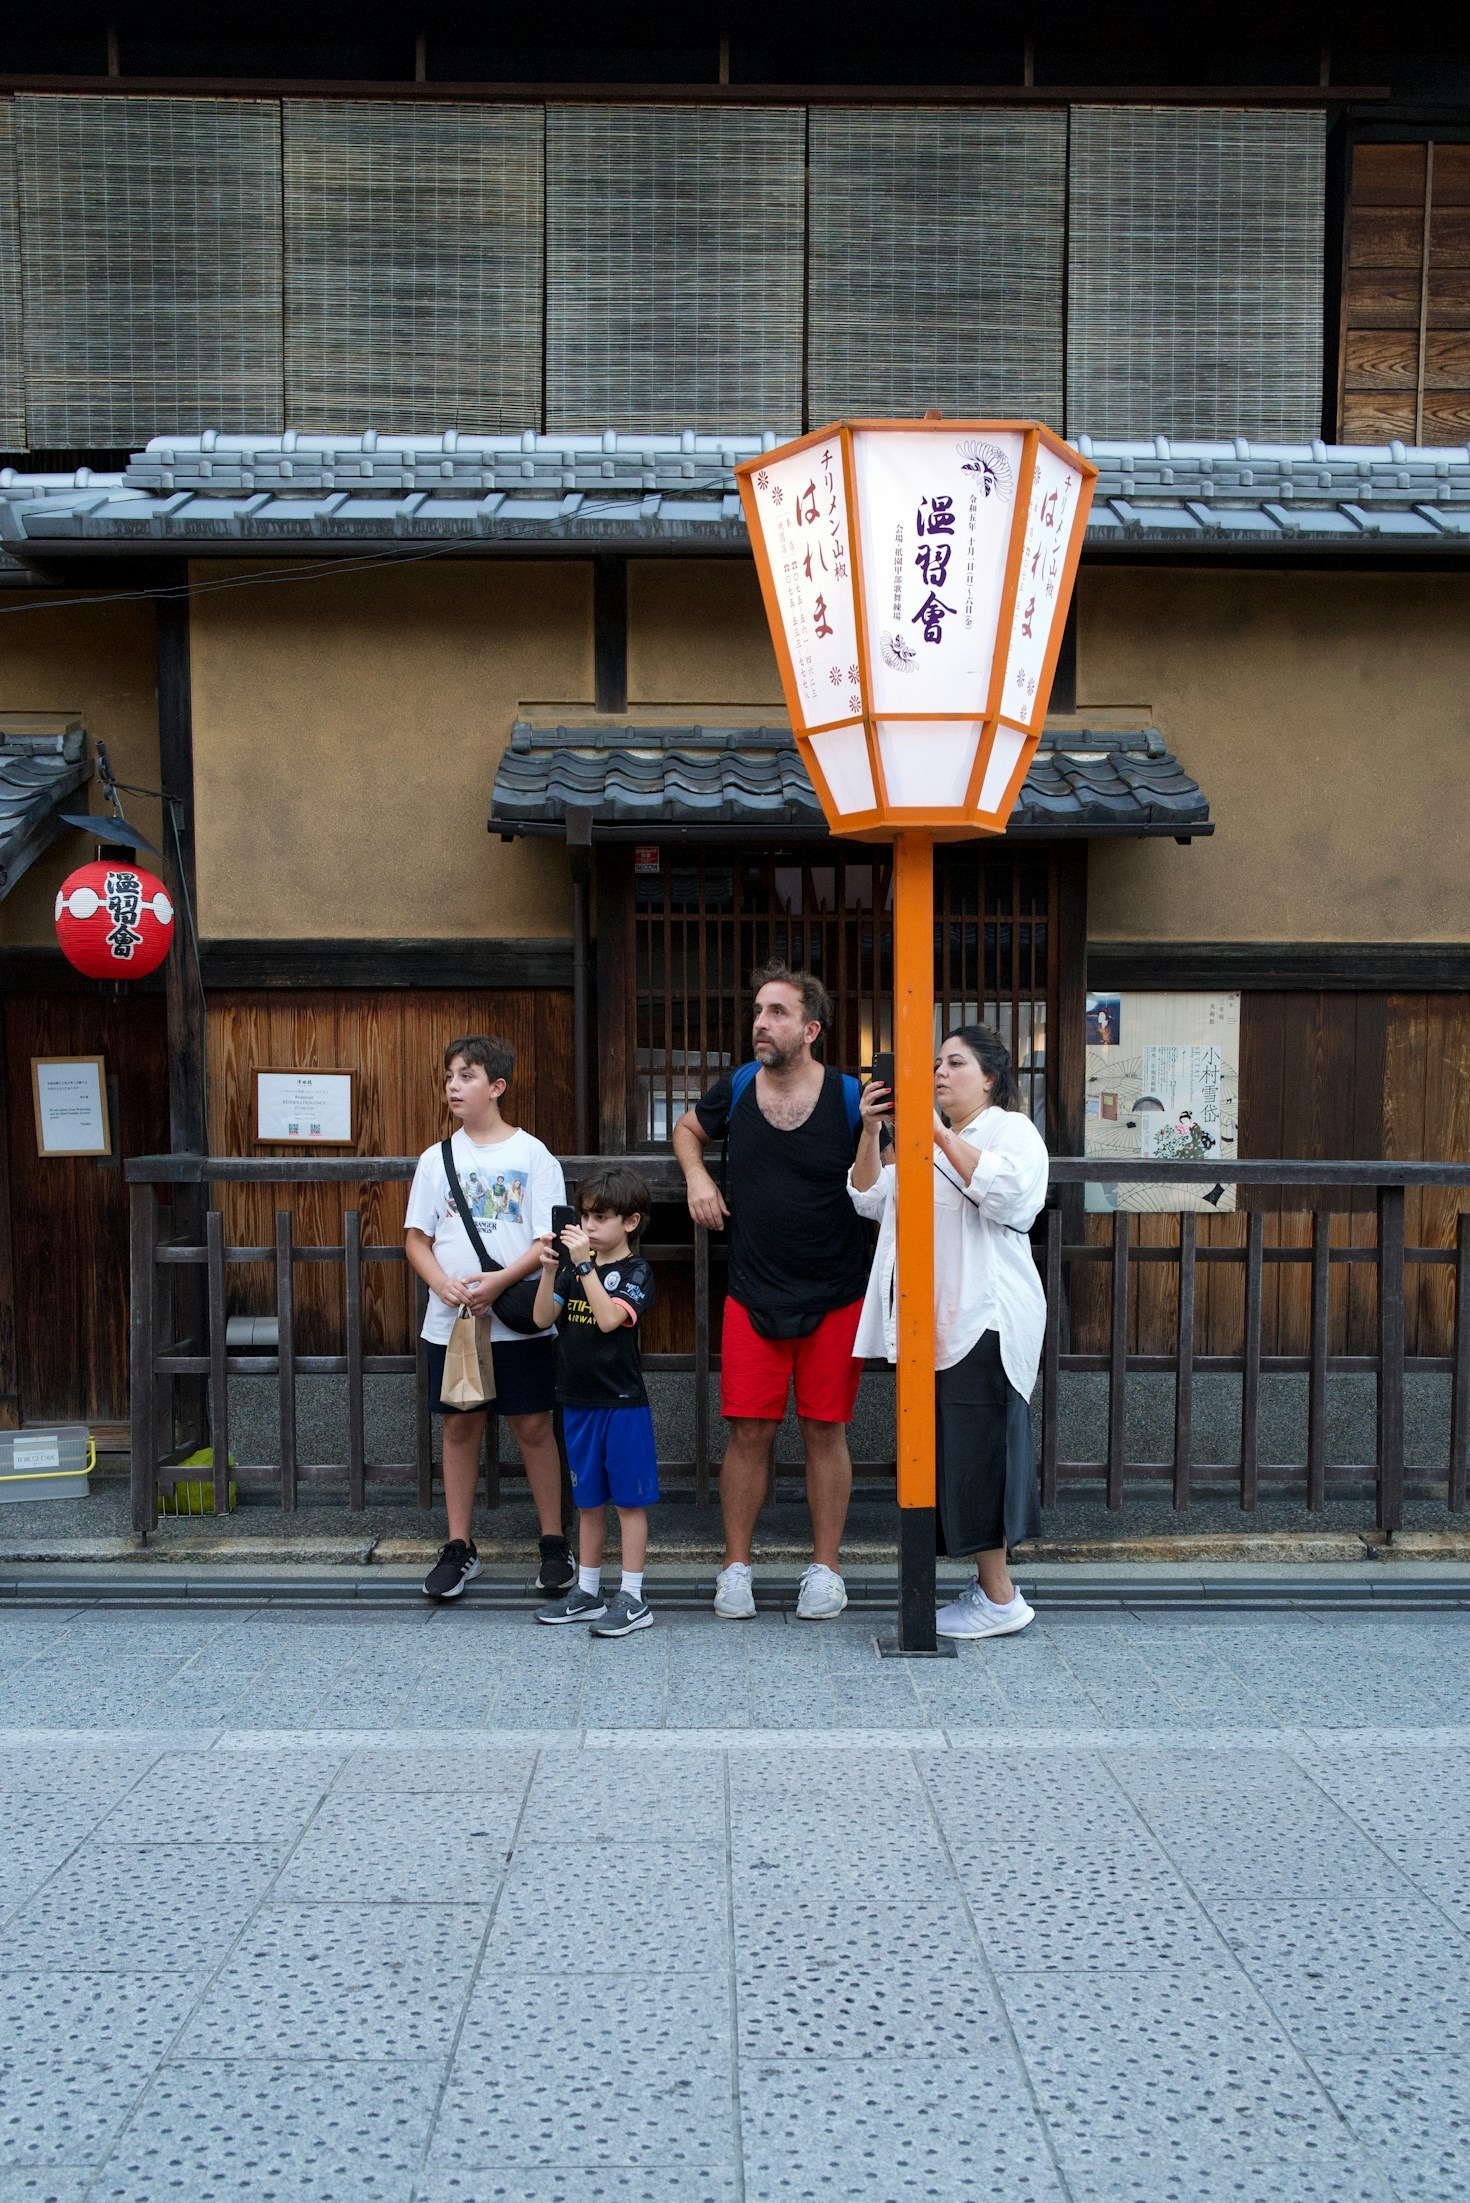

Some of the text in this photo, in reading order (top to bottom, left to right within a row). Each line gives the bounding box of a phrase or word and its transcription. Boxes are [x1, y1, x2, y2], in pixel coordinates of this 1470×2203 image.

[795, 478, 834, 639] はれま
[821, 449, 848, 582] チリメン山椒
[968, 494, 977, 532] 令和五年
[1022, 486, 1058, 639] はれま
[1199, 1046, 1221, 1123] 小村雪岱
